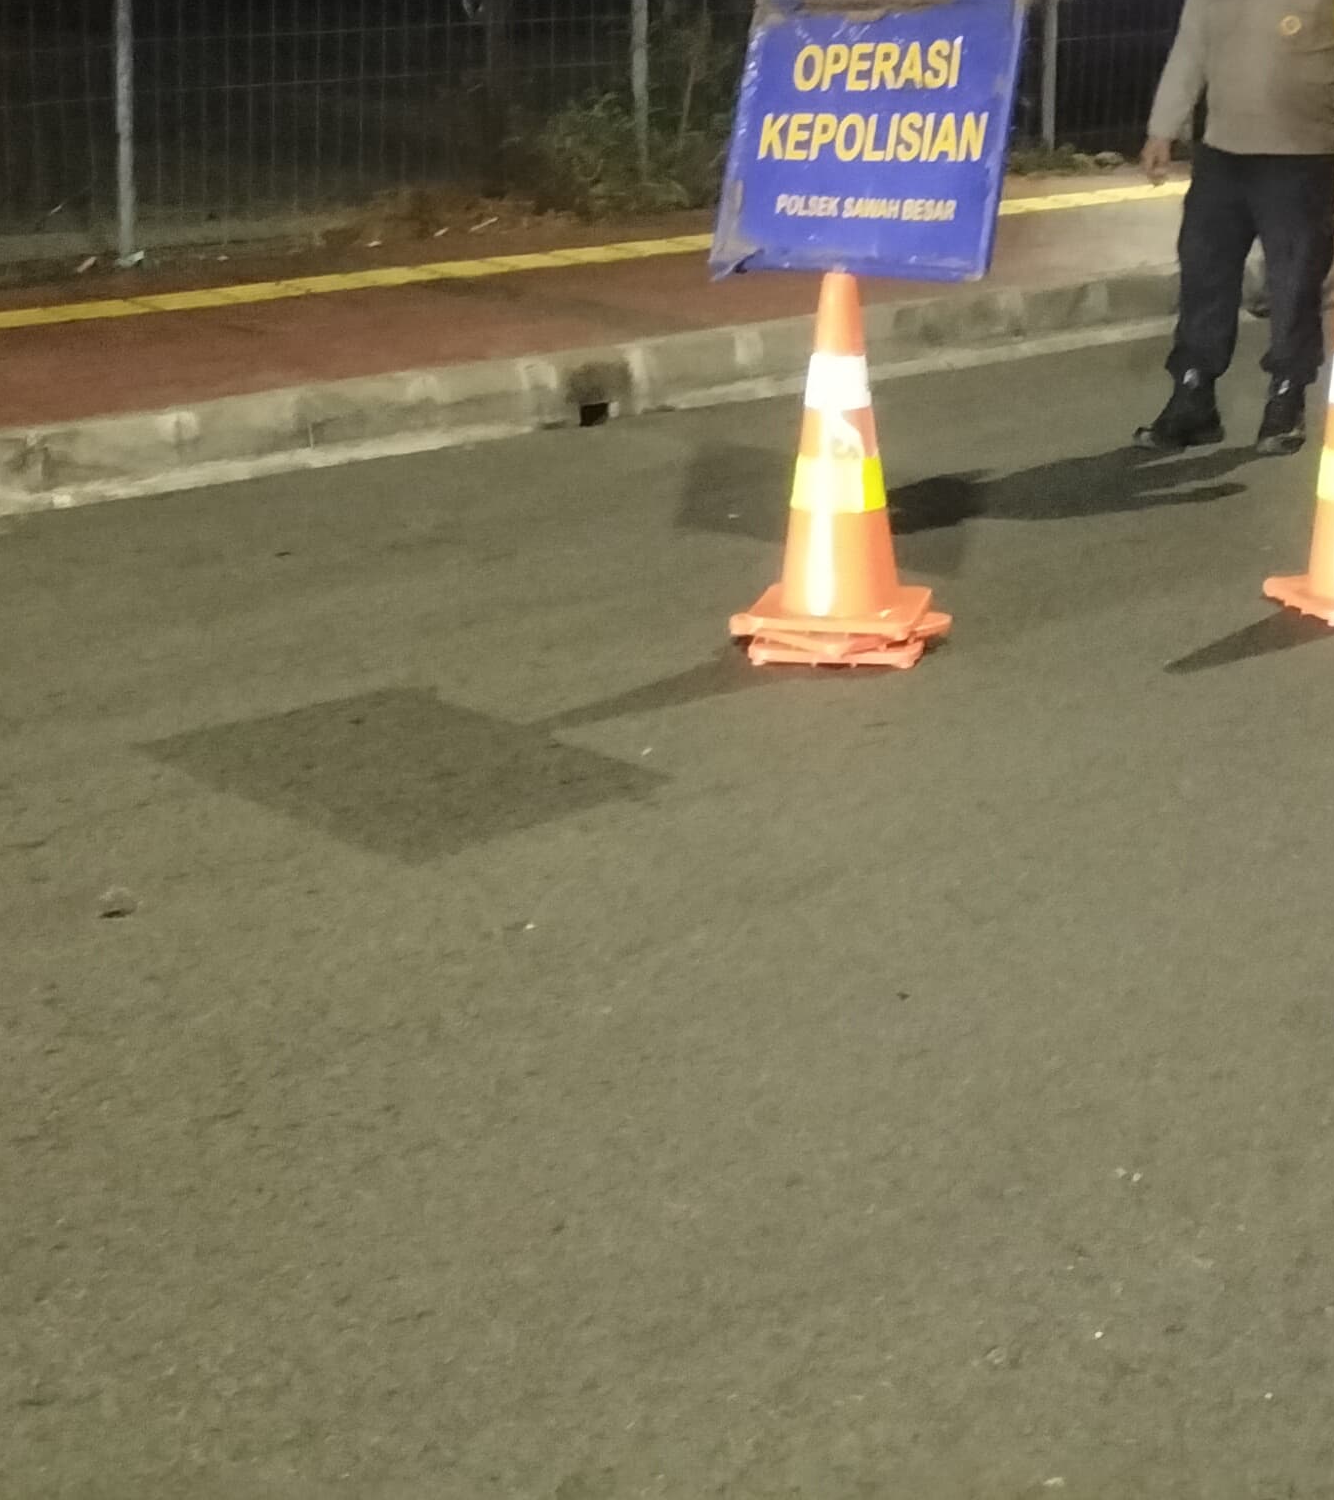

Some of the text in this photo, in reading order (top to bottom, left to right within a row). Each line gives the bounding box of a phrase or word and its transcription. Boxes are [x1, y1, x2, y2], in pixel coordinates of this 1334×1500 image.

[793, 36, 964, 91] OPERASI
[757, 111, 989, 162] KEPOLISIAN
[775, 194, 957, 221] POLSEK SAWAH BESAR
